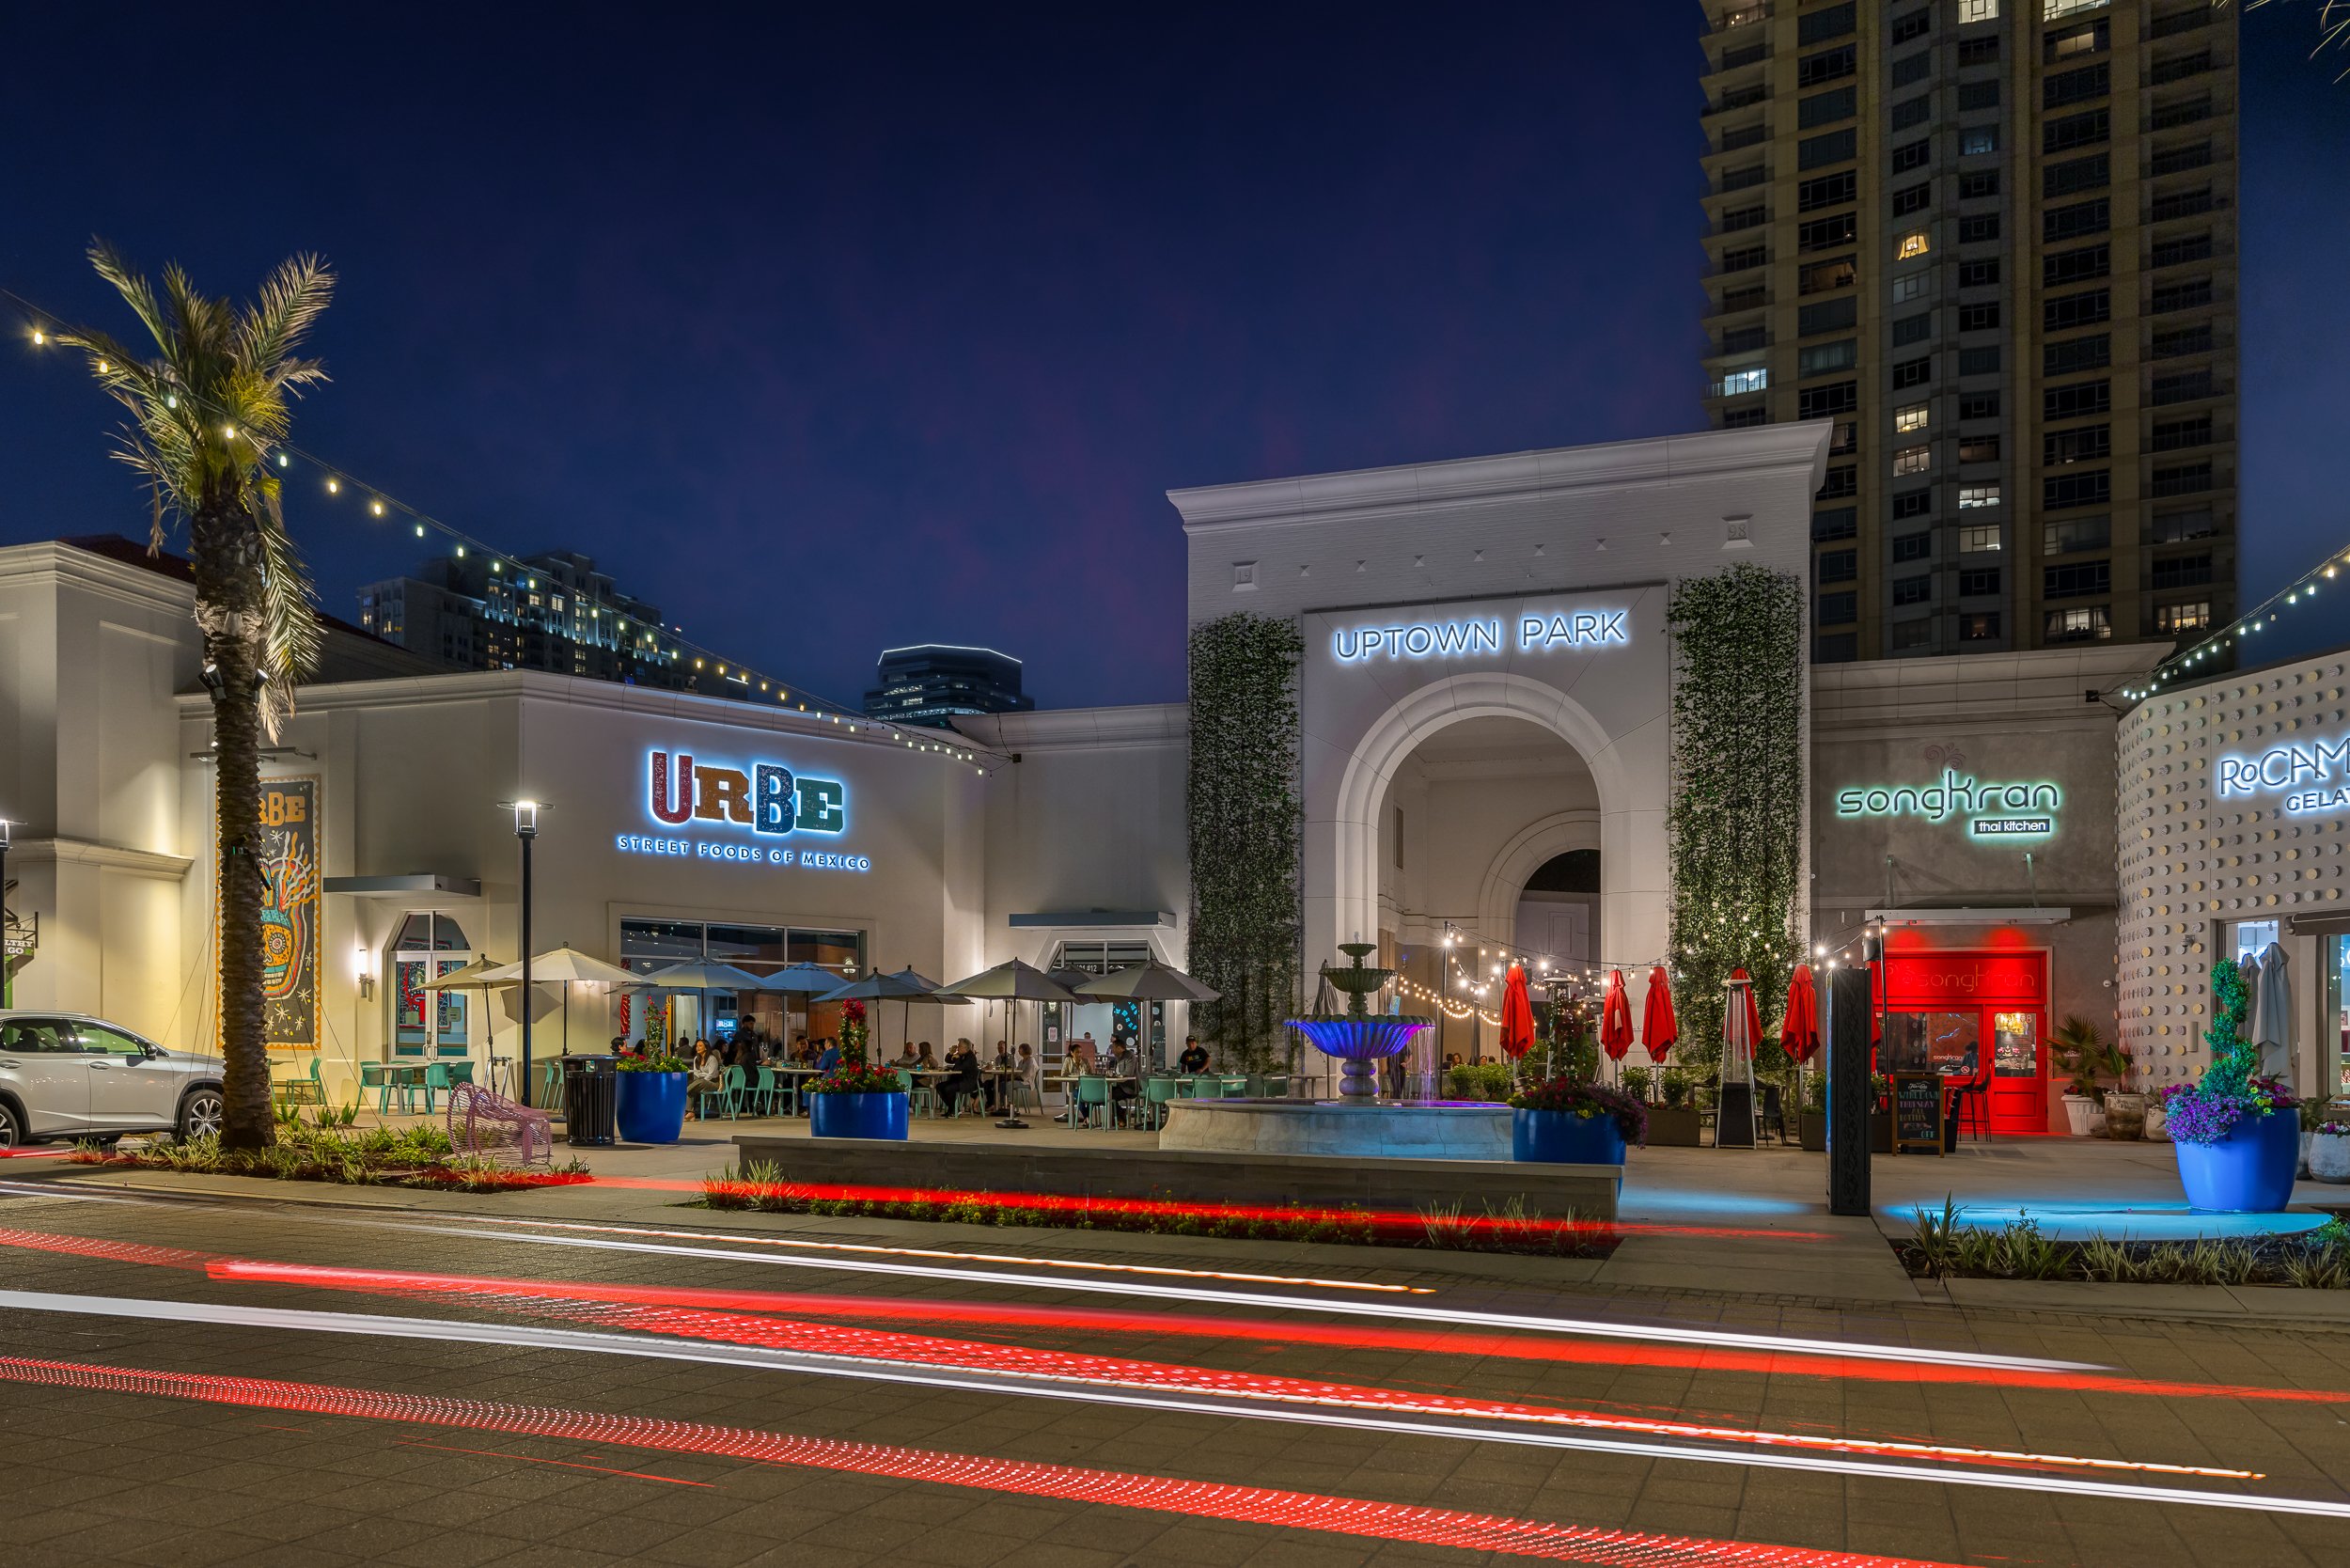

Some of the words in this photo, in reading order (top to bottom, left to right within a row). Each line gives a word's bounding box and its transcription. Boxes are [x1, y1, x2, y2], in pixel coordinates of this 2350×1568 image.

[1336, 621, 1497, 658] UPTOWN
[1523, 612, 1624, 646] PARK
[2220, 738, 2350, 794] RoCAM
[258, 792, 306, 827] BE
[651, 751, 843, 834] URBE
[1840, 770, 2058, 820] songkran
[1979, 821, 2000, 832] thai
[2004, 820, 2046, 831] kitchen
[620, 837, 688, 854] STREET
[700, 844, 760, 859] FOODS
[772, 851, 793, 862] OF
[803, 853, 870, 869] MEXICO
[1918, 964, 2034, 992] songkran
